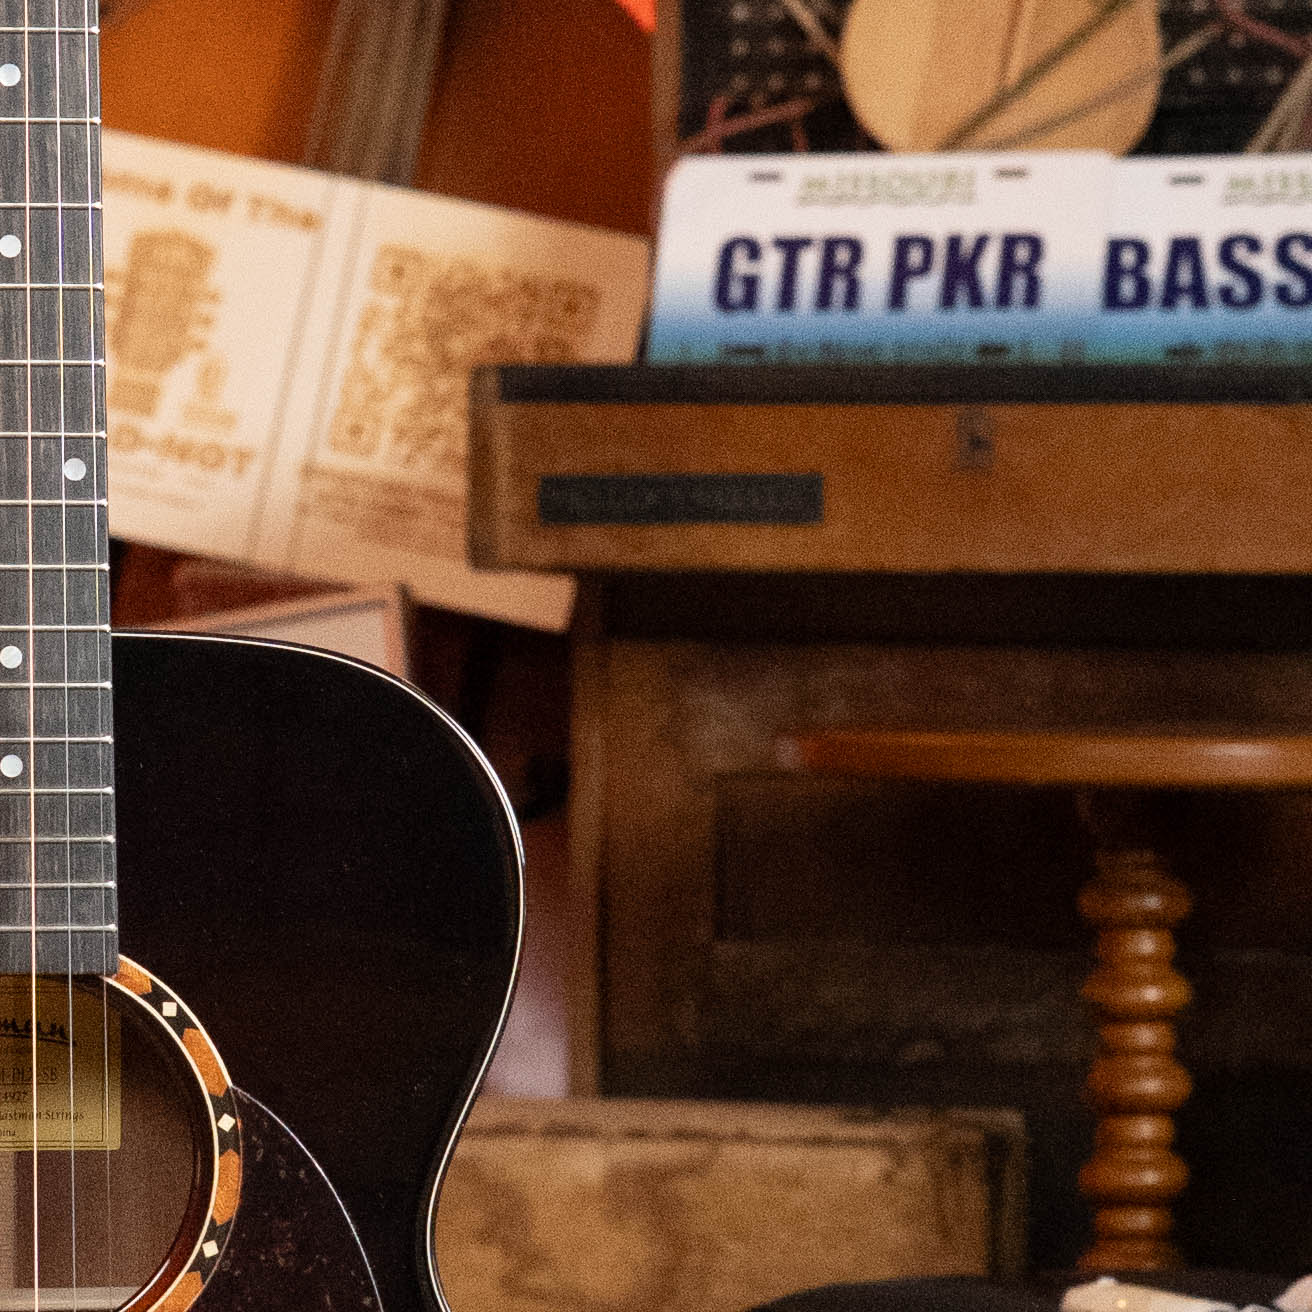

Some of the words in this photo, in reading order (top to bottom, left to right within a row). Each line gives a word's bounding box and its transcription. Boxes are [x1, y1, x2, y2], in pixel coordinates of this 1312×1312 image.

[713, 235, 865, 313] GTR
[887, 233, 1046, 312] PKR
[1102, 232, 1312, 313] BASS
